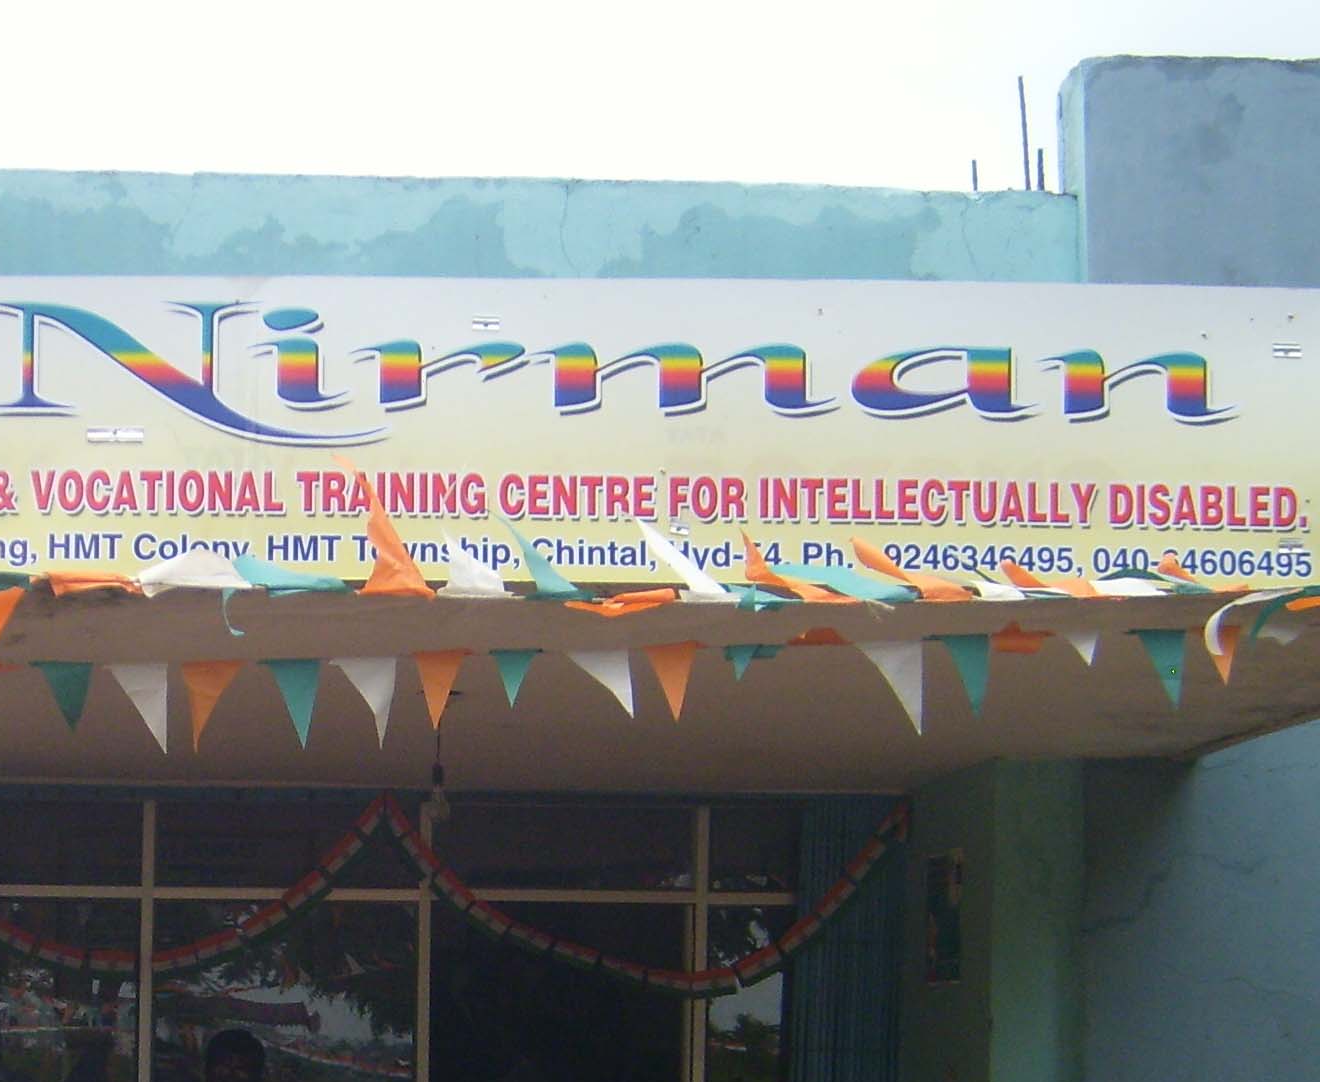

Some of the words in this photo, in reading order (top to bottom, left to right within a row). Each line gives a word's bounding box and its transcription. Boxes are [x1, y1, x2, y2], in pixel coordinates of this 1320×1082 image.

[30, 469, 285, 514] VOCATIONAL
[295, 470, 486, 516] TRAINING
[499, 474, 655, 518] CENTRE
[668, 475, 746, 520] FOR
[759, 477, 1097, 525] INTELLECTUALLY
[1109, 483, 1309, 528] DISABLED.
[48, 533, 123, 560] HMT
[267, 534, 342, 561] HMT
[802, 541, 854, 569] Ph.
[1092, 548, 1312, 577] 040-4606495
